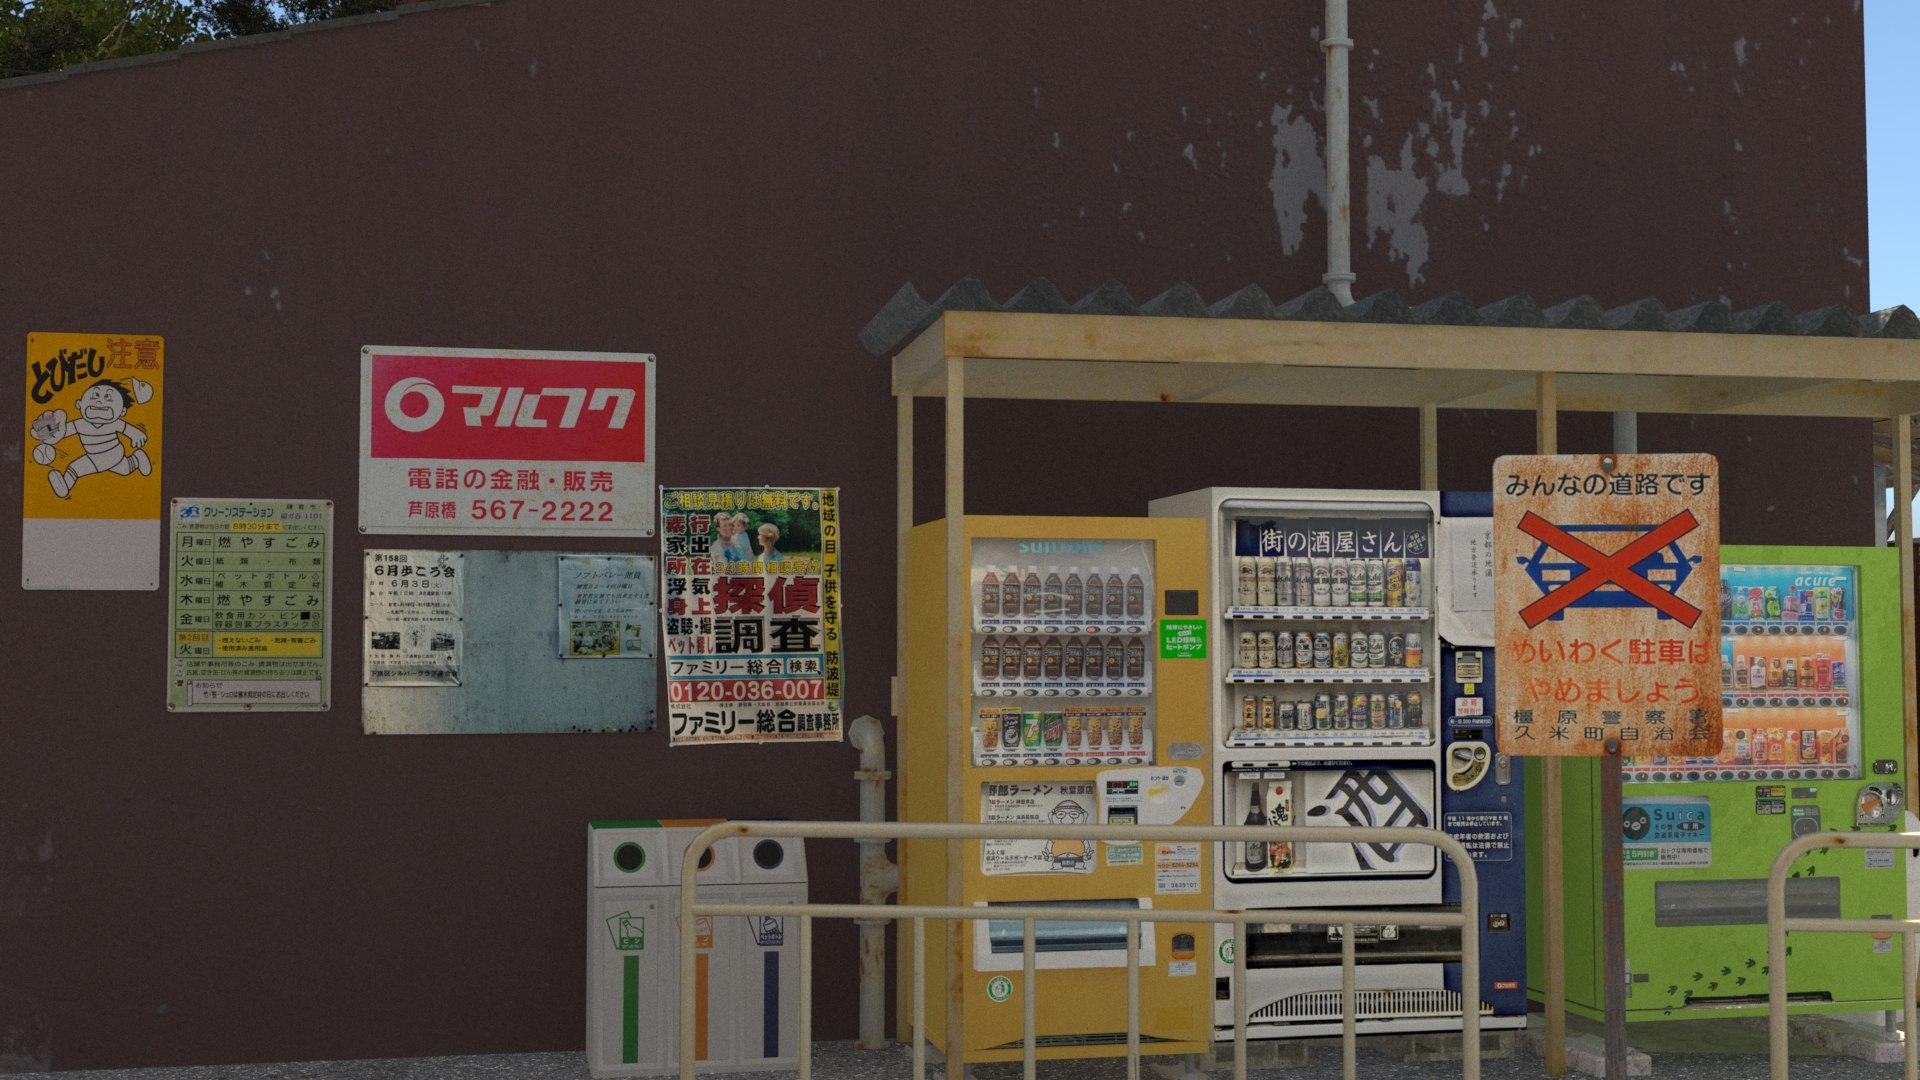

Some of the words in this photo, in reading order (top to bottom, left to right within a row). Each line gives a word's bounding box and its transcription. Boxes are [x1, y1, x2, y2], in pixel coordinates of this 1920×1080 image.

[31, 348, 105, 404] とびだし
[106, 338, 160, 370] 注意
[451, 385, 636, 429] マルフク
[408, 468, 613, 492] 電話の金融・販売
[1506, 474, 1710, 497] みんなの道路です
[664, 491, 820, 510] ご相談見積りは無料です。
[204, 507, 274, 518] クリーンステーション
[408, 501, 457, 519] 芦原橋
[472, 500, 613, 522] 567-2222
[666, 515, 710, 533] 素行
[822, 493, 836, 554] 地域の目
[182, 536, 211, 547] 月曜日
[218, 537, 320, 548] 燃やすごみ
[666, 537, 710, 554] 家出
[1262, 528, 1402, 553] 街の酒屋さん
[181, 555, 211, 566] 火曜日
[375, 554, 407, 562] 第158回
[666, 558, 711, 575] 所在
[180, 575, 210, 587] 水曜日
[667, 578, 710, 595] 浮気
[1795, 576, 1837, 587] acure
[180, 594, 210, 605] 木曜日
[217, 594, 319, 606] 燃やすごみ
[713, 576, 821, 614] 探偵
[824, 564, 838, 641] 子供を守る
[668, 598, 711, 615] 身上
[180, 613, 210, 625] 金曜日
[714, 616, 820, 653] 調査
[180, 644, 210, 655] 火曜日
[1513, 639, 1709, 665] めいわく駐車は
[671, 659, 782, 674] ファミリー総合
[790, 659, 818, 673] 検索
[826, 651, 840, 697] 防波堤
[671, 680, 823, 701] 0120-036-007
[1525, 679, 1700, 704] やめましょう
[1514, 727, 1709, 741] 久米町自治会
[1654, 808, 1705, 820] Suica
